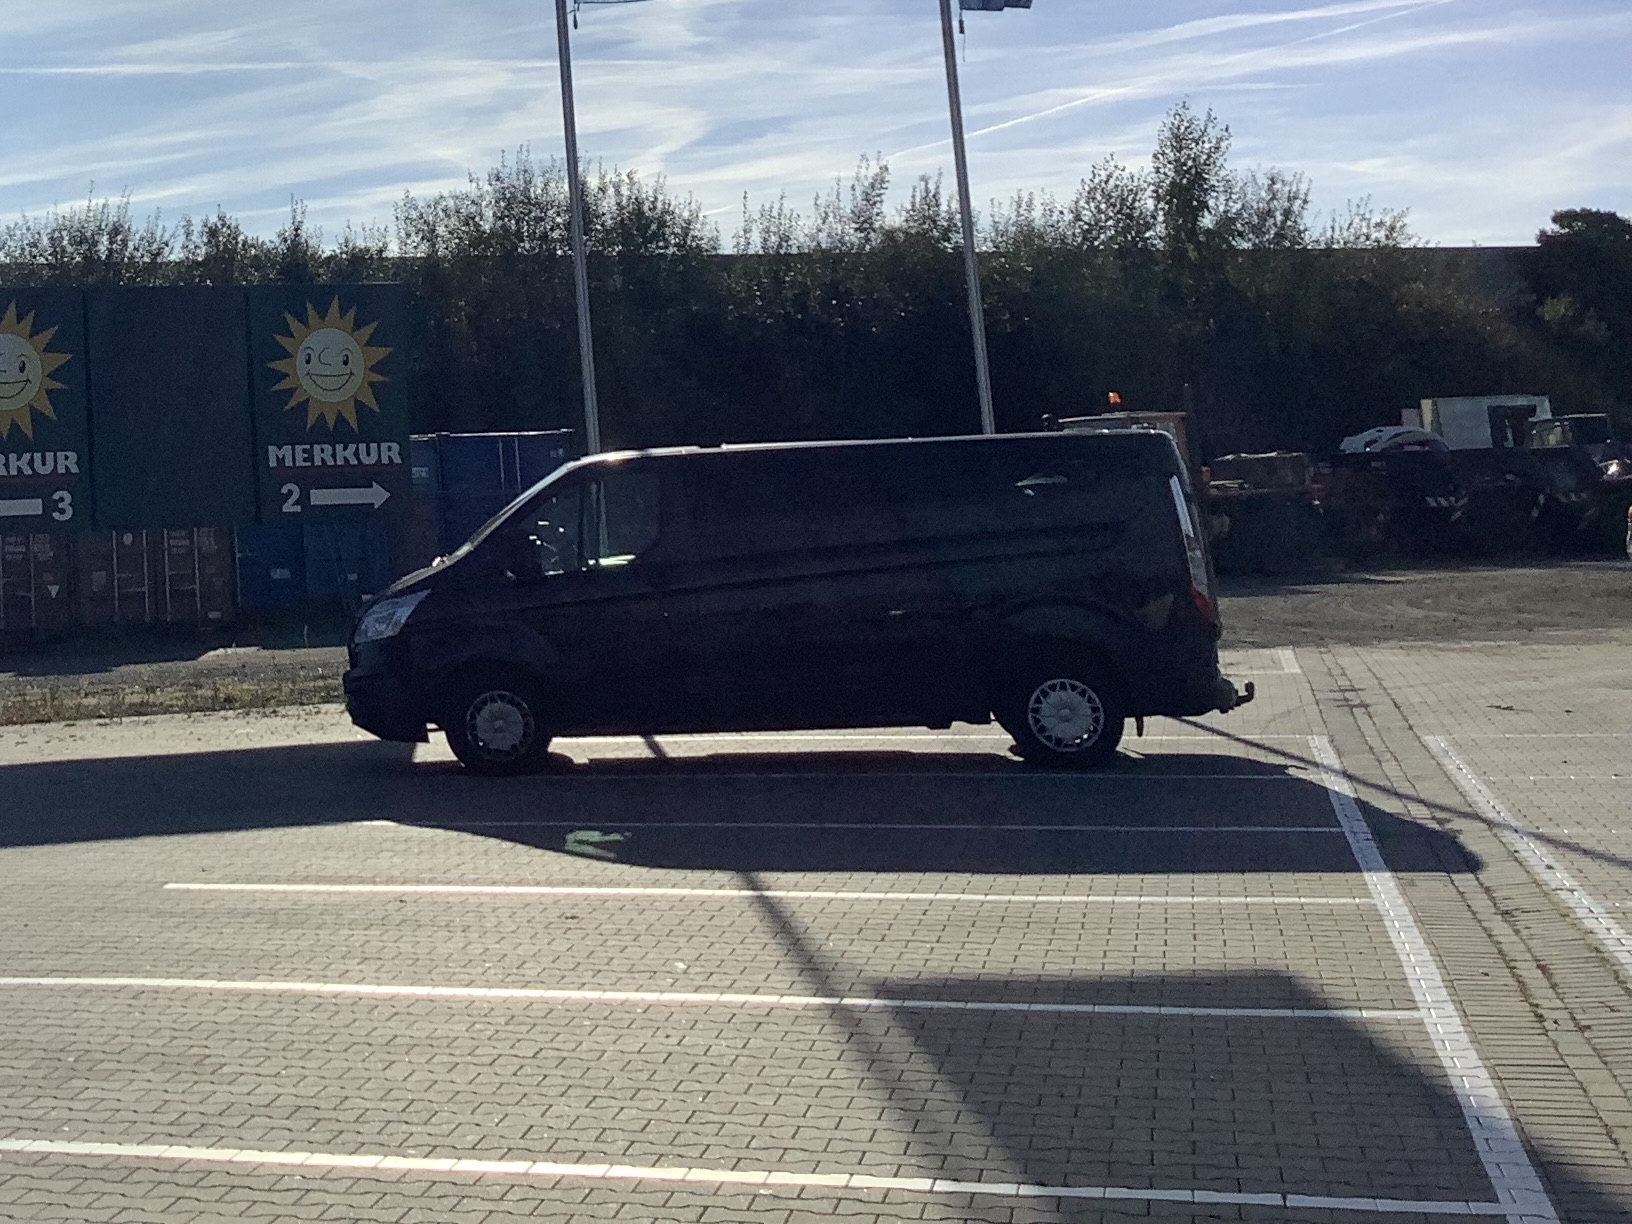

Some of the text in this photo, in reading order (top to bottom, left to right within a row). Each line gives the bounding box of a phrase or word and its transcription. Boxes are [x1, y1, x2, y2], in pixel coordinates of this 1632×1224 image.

[269, 441, 402, 468] MERKUR
[52, 490, 74, 522] 3
[280, 482, 302, 513] 2
